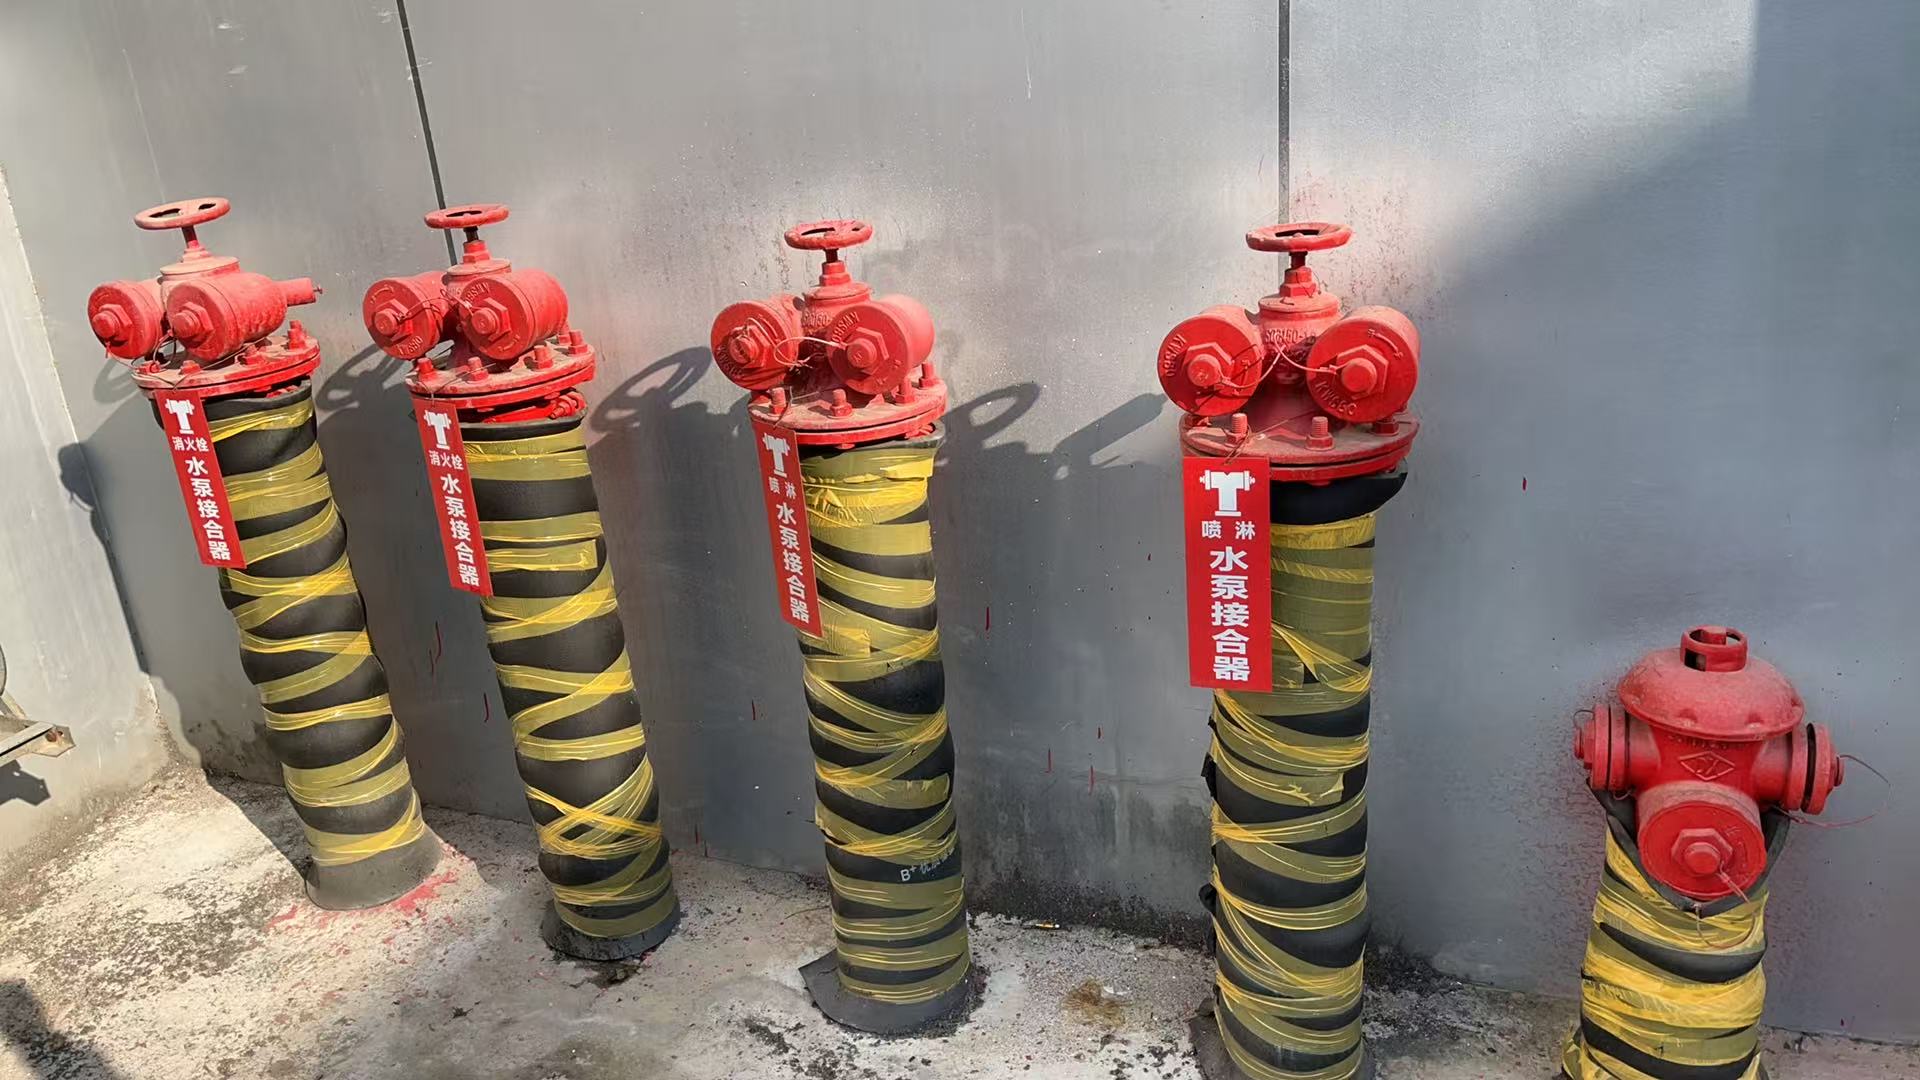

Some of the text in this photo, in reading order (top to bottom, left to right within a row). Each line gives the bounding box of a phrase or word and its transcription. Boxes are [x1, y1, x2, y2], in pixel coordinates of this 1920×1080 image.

[171, 436, 209, 452] 消火栓
[428, 450, 464, 470] 消火栓
[185, 456, 231, 561] 水泵接合器
[769, 477, 796, 498] 喷淋
[440, 473, 480, 587] 水泵接合器
[1201, 519, 1256, 540] 喷淋
[776, 502, 810, 624] 水泵接合器
[1209, 546, 1251, 682] 水泵接合器
